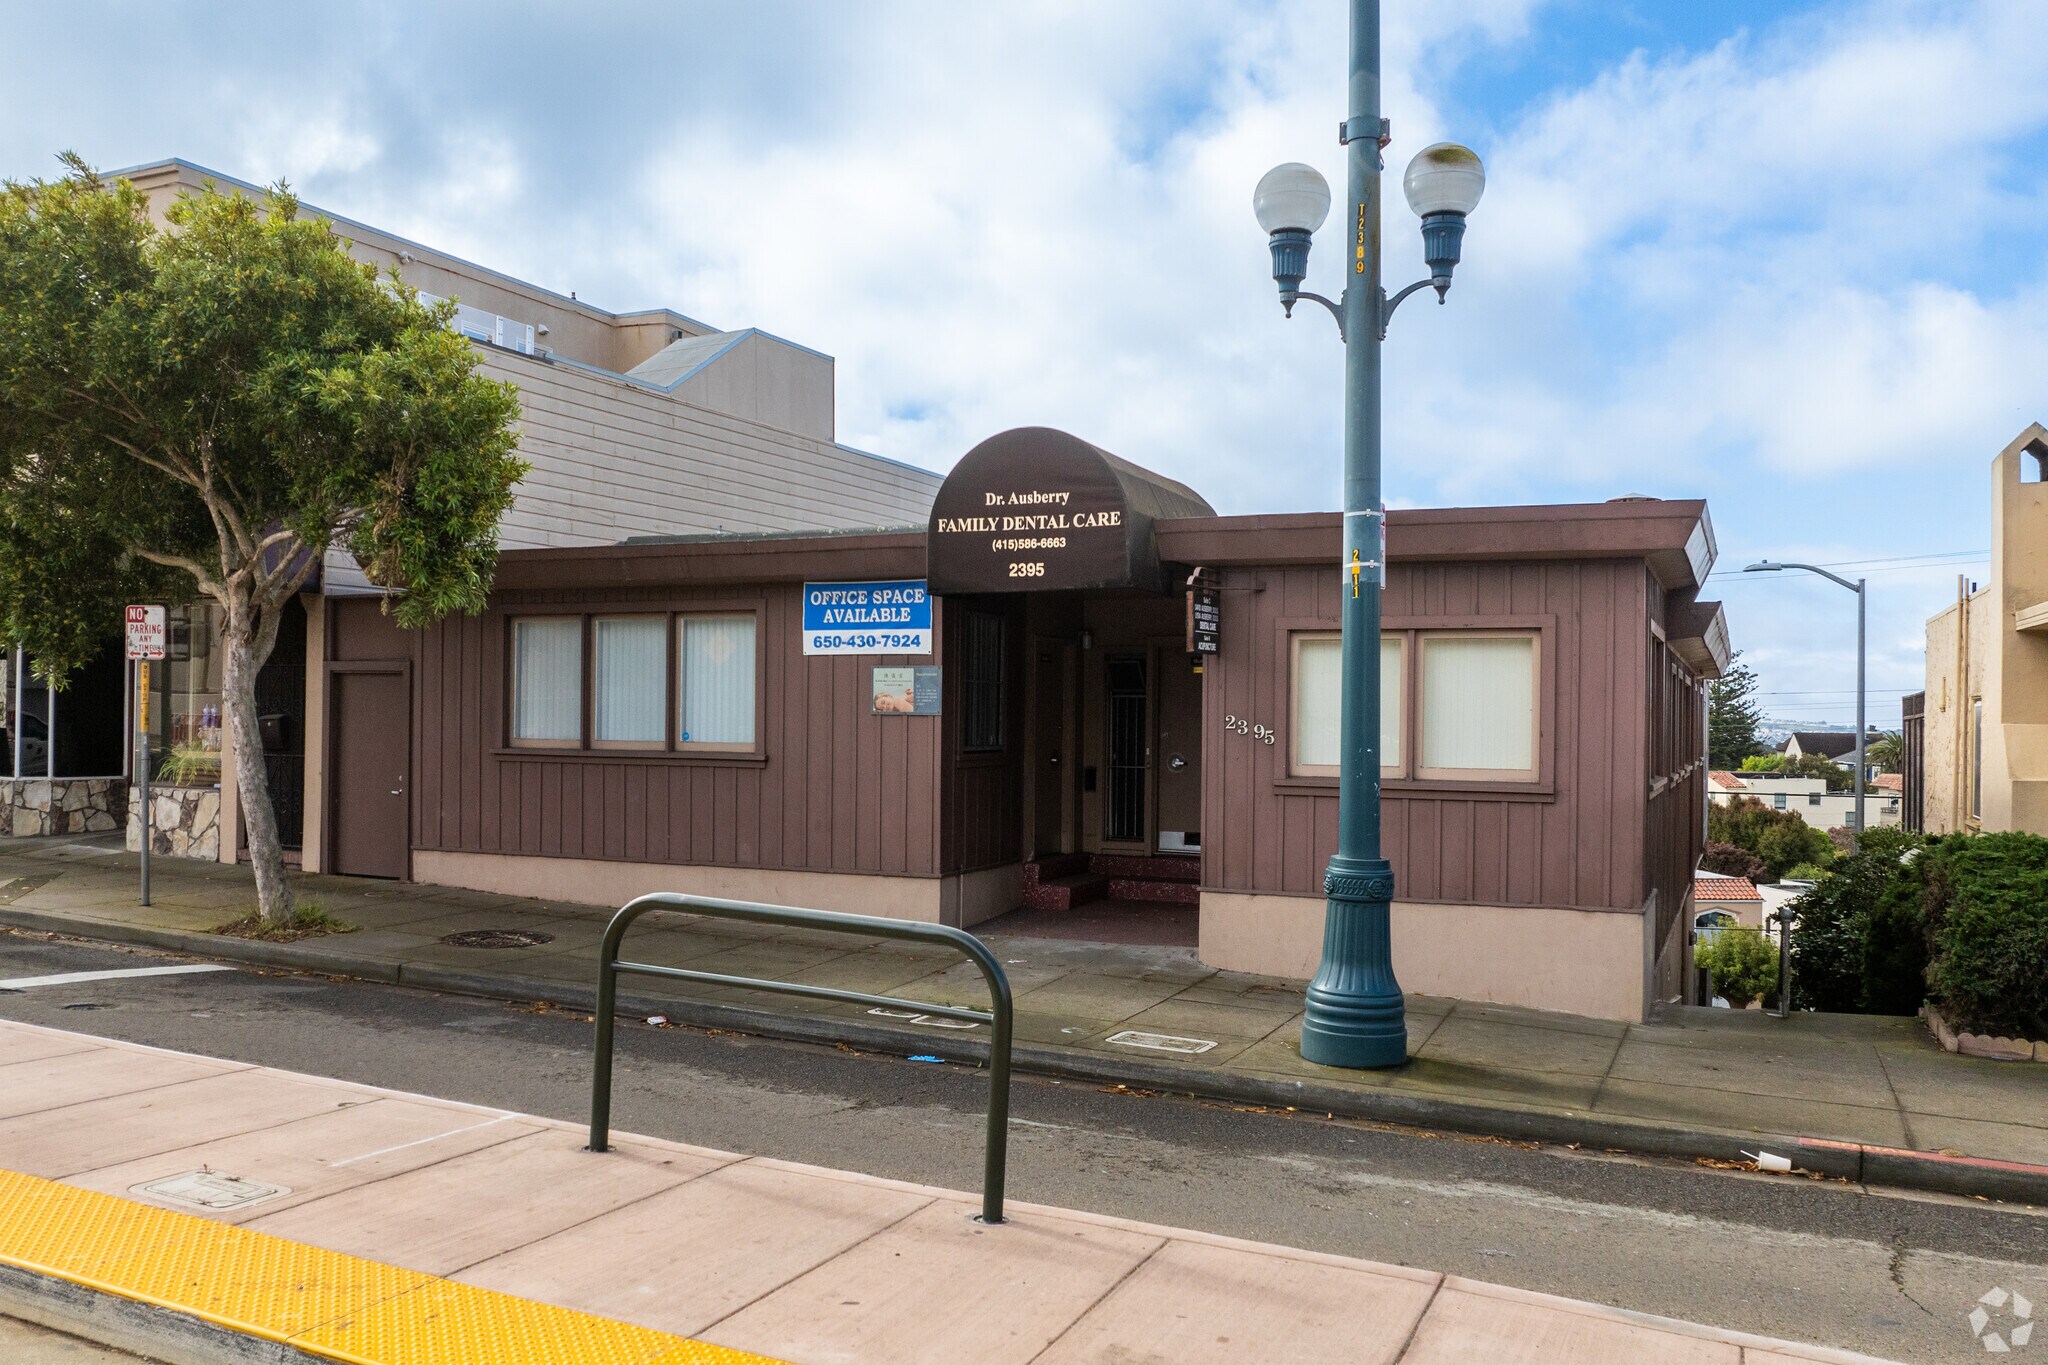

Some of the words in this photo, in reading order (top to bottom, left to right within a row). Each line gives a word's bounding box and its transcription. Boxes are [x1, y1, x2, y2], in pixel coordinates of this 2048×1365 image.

[985, 492, 1005, 506] Dr.
[1008, 490, 1070, 506] Ausberry
[937, 517, 1000, 533] FAMILY
[1002, 514, 1070, 532] DENTAL
[1072, 511, 1122, 528] CARE
[992, 537, 1067, 553] (415)586-6663
[1009, 562, 1045, 577] 2395
[810, 590, 868, 606] OFFICE
[872, 588, 925, 605] SPACE
[129, 608, 143, 620] NO
[823, 607, 911, 624] AVAILABLE
[130, 624, 162, 634] PARKING
[139, 644, 154, 652] TIME
[813, 634, 921, 649] 650-430-7924
[1225, 714, 1275, 745] 2395
